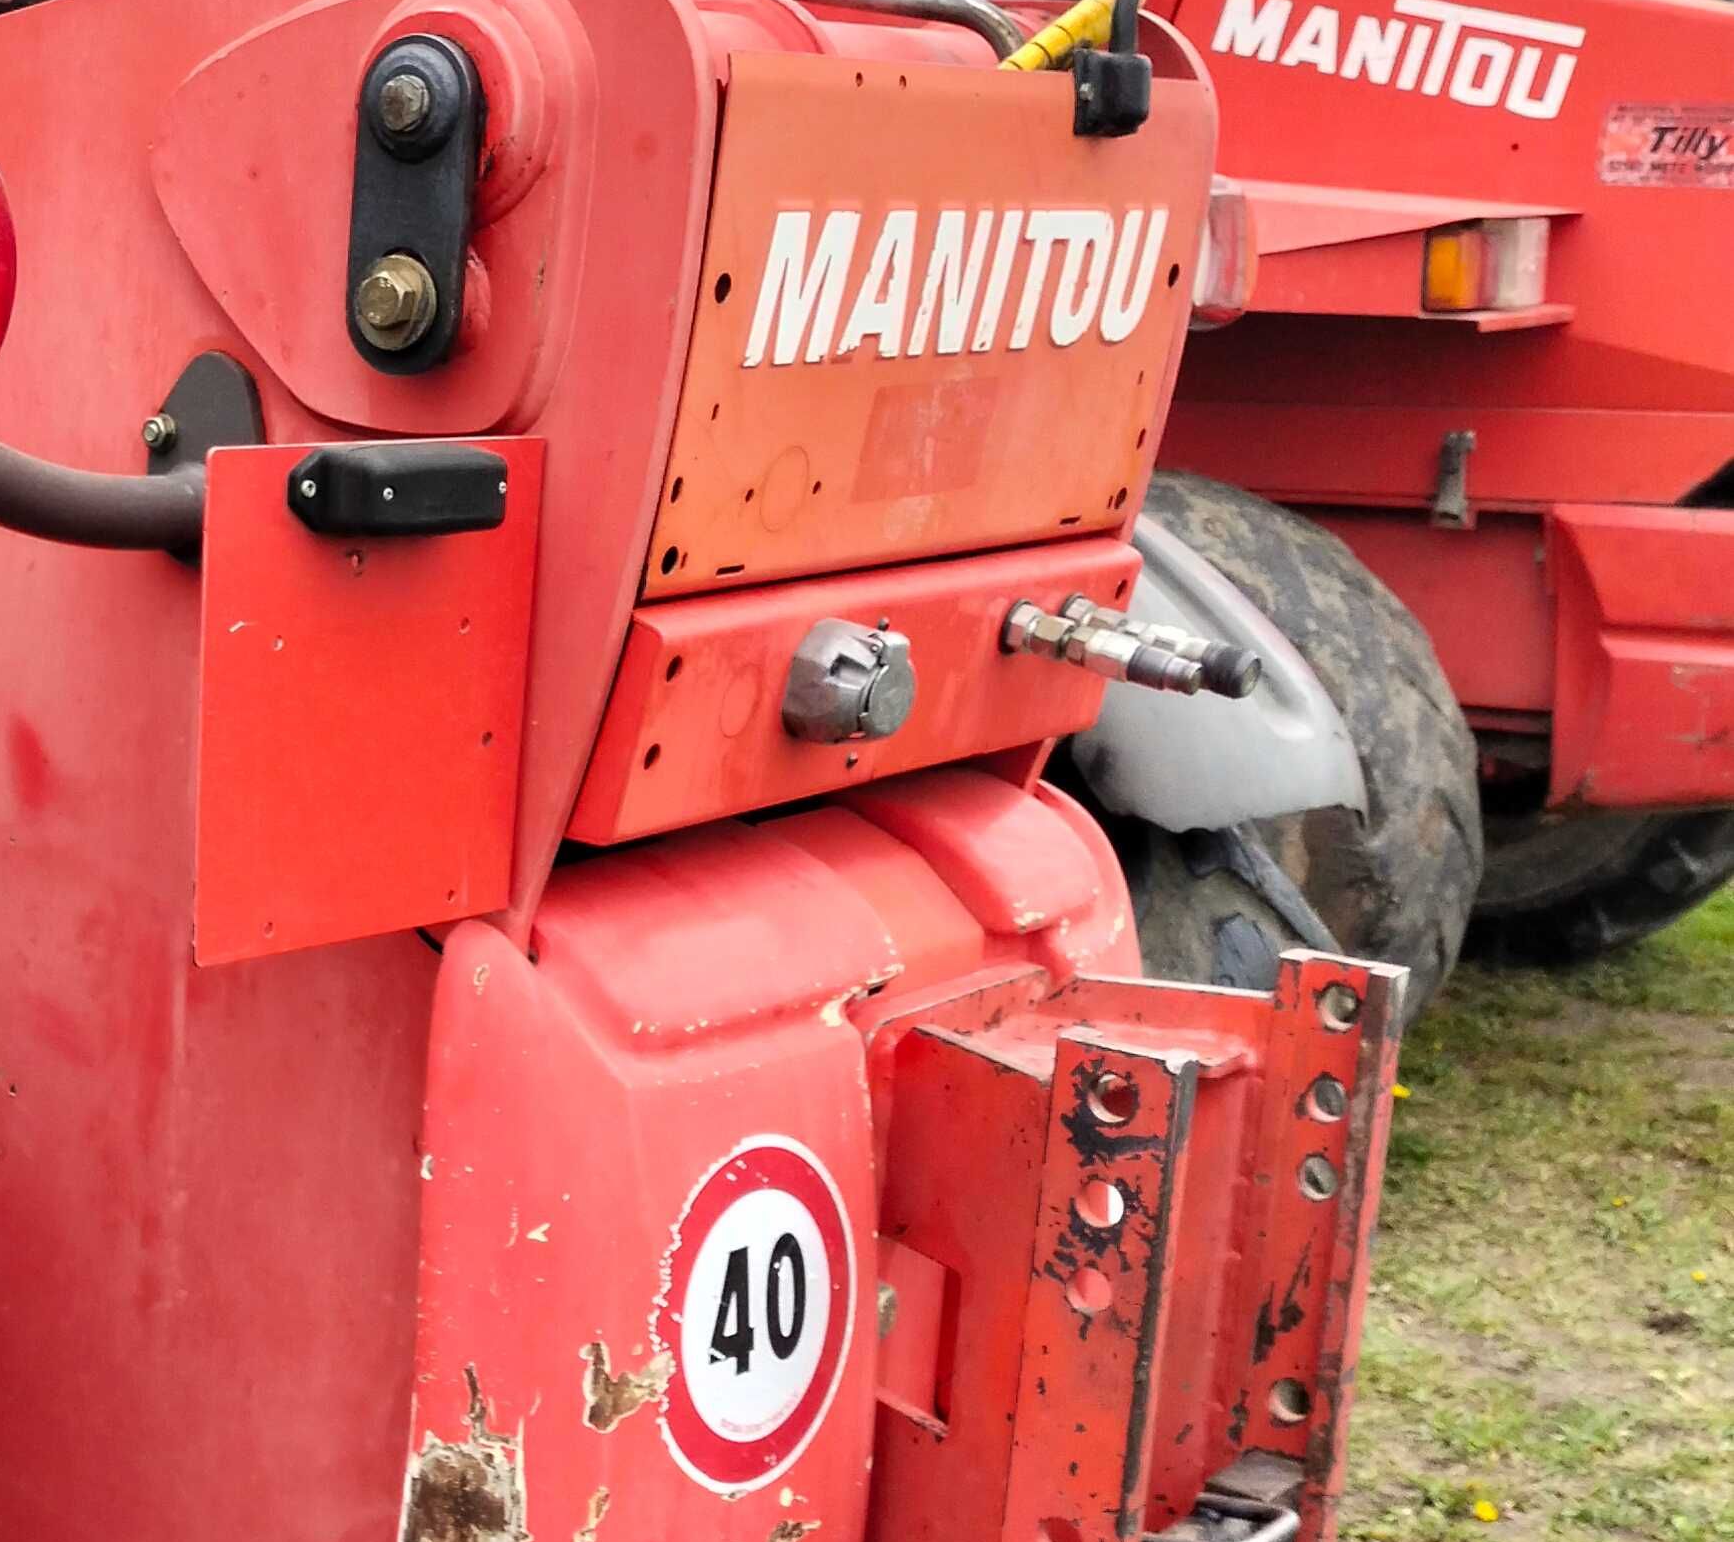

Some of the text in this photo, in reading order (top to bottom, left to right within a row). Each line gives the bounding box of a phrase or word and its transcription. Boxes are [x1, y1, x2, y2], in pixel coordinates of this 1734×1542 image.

[1650, 126, 1731, 160] Tilly
[741, 209, 1169, 368] MANITOU
[708, 1232, 807, 1376] 40
